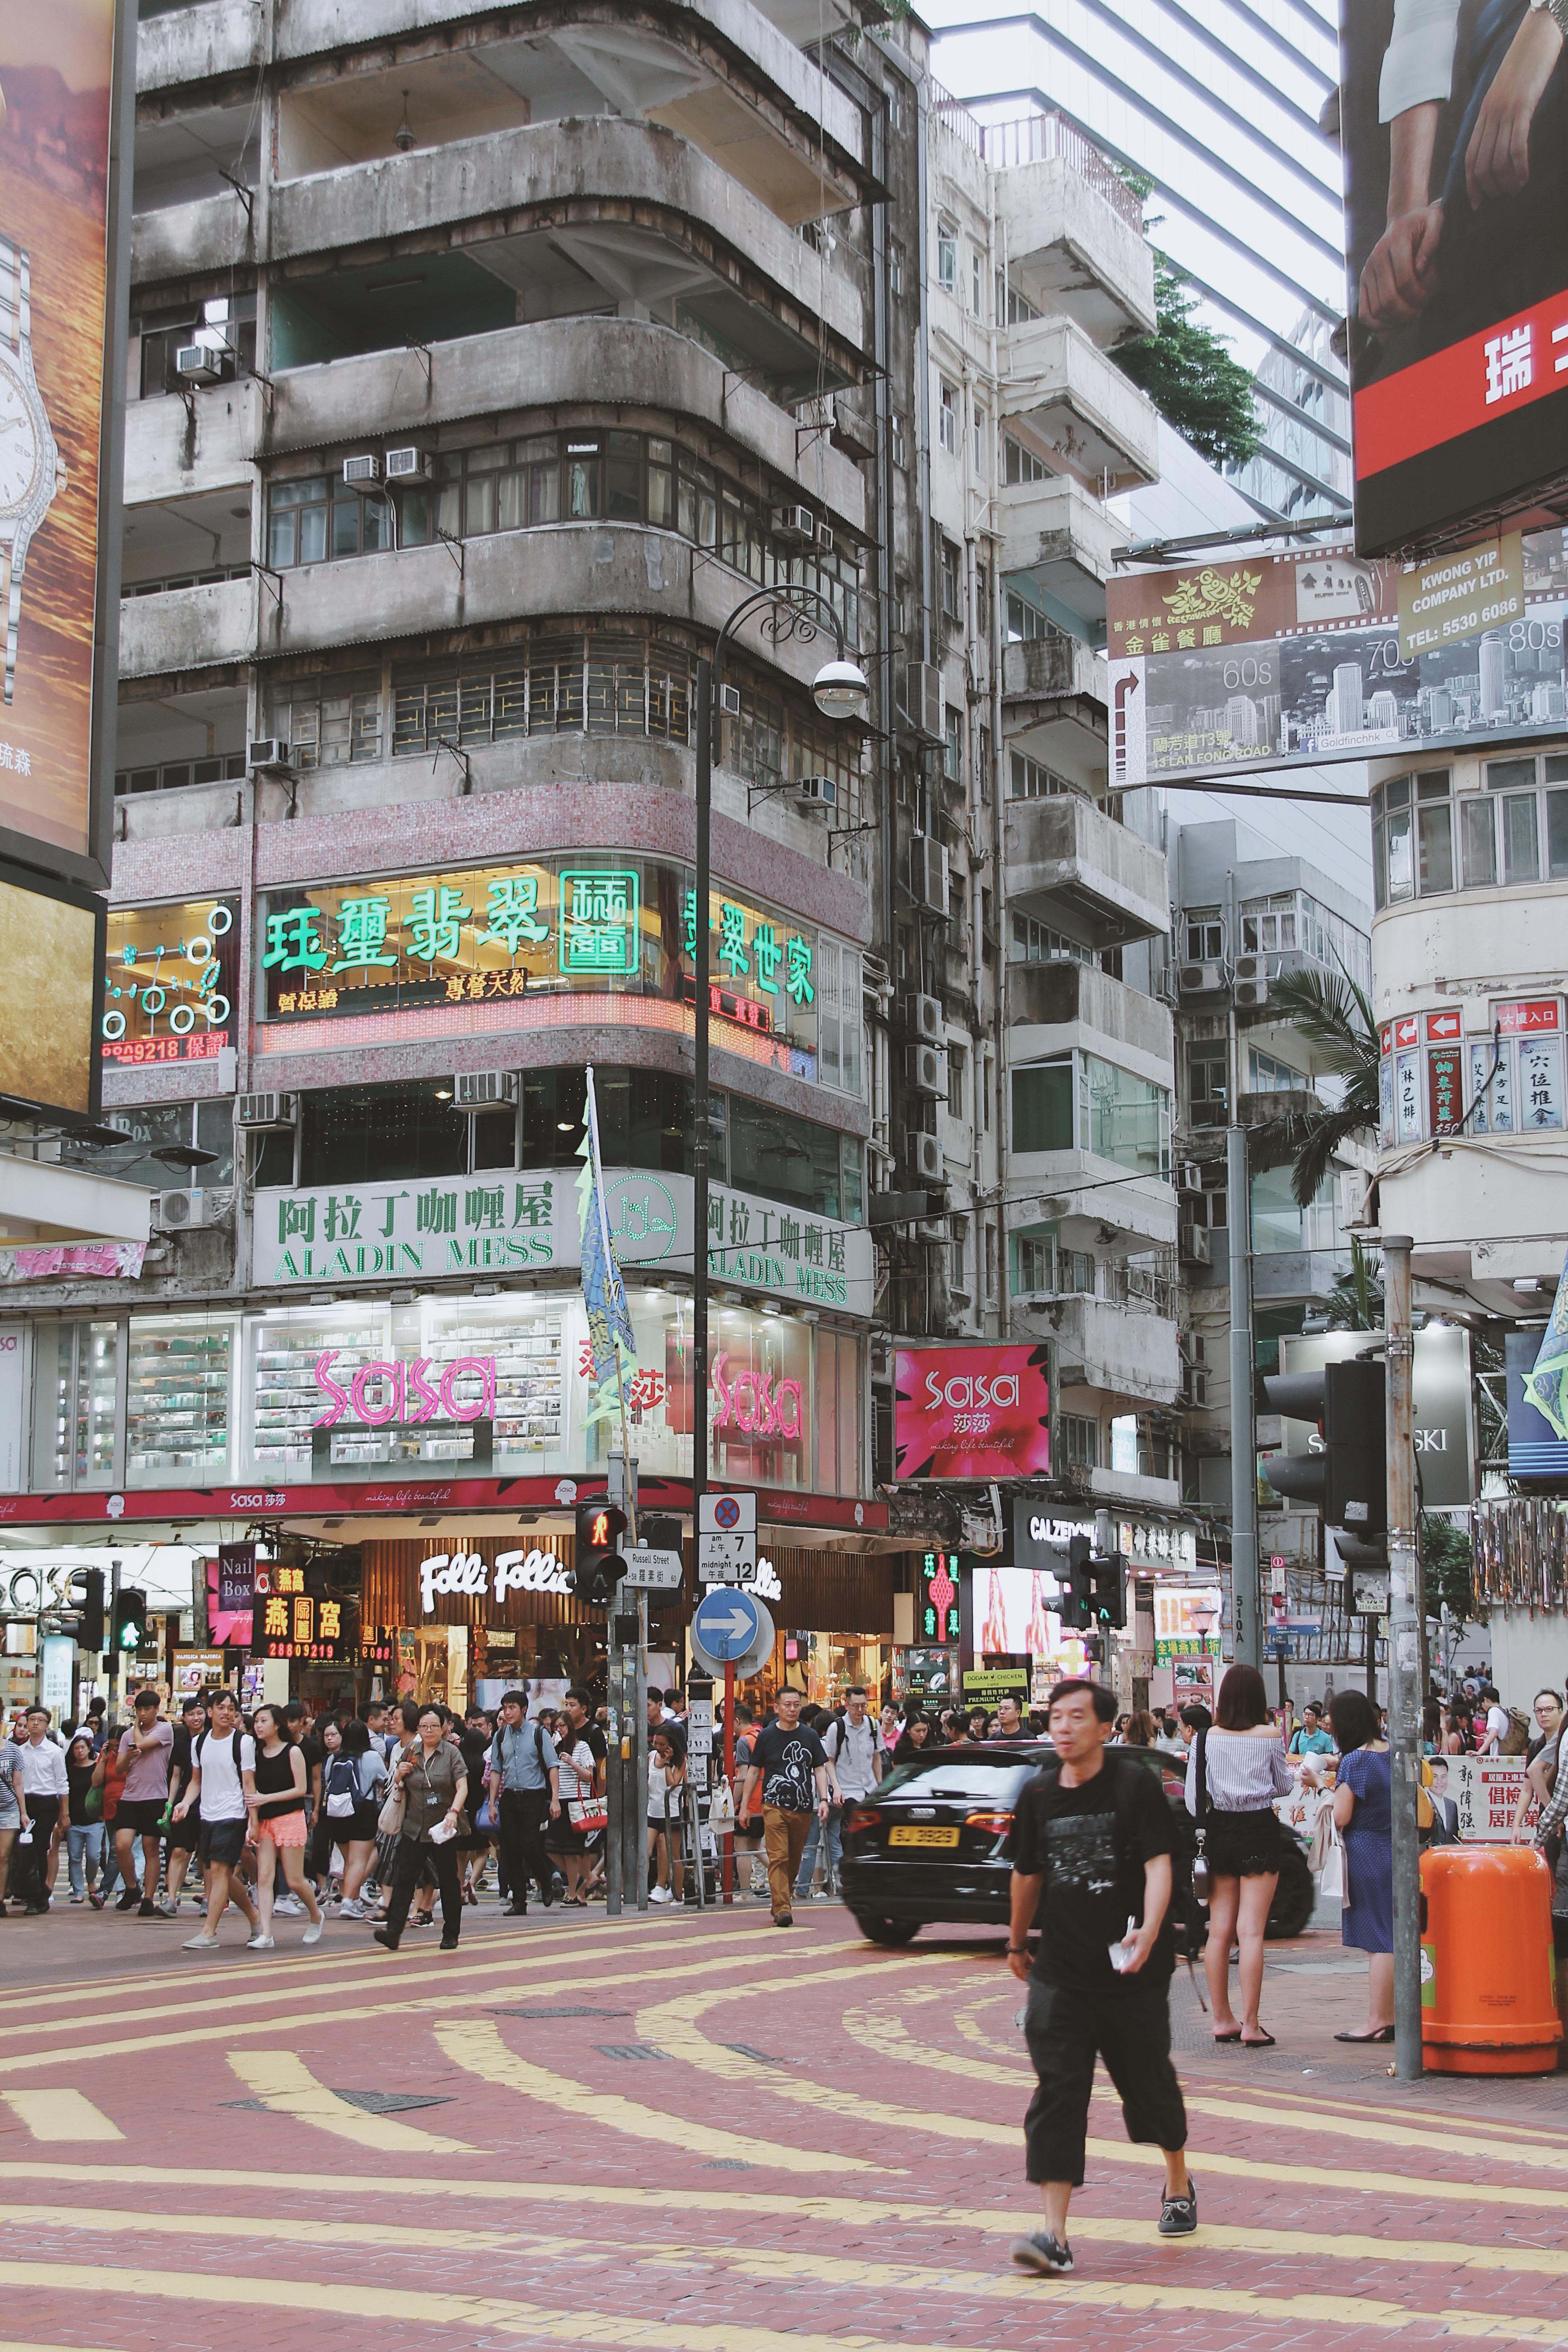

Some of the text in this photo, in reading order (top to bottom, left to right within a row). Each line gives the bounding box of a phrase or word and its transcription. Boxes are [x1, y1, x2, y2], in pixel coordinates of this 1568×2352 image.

[1421, 551, 1498, 591] KWONG YIP
[1412, 568, 1509, 614] COMPANY LTD.
[1113, 617, 1162, 633] 香港情懷
[1166, 605, 1224, 625] RESTAURANT
[1406, 597, 1517, 650] TEL: 5530 6086
[1125, 625, 1222, 656] 金雀餐廳
[1509, 621, 1561, 652] 80s
[1223, 657, 1272, 689] 60s
[1152, 730, 1231, 753] 蘭芳道13號
[1320, 732, 1380, 749] Goldfinchhk
[1152, 745, 1271, 768] 13 LAN FONG ROAD
[279, 991, 338, 1014] 質保證
[1502, 1009, 1553, 1027] 大廈入口
[1494, 1061, 1510, 1122] 古方足療
[1529, 1055, 1554, 1126] 穴位推拿
[279, 1181, 554, 1245] 阿拉丁咖喱屋
[708, 1192, 847, 1273] 阿拉丁咖喱屋
[272, 1233, 554, 1279] ALADIN MESS
[707, 1244, 848, 1305] ALADIN MESS
[925, 1371, 1019, 1410] Sasa
[953, 1412, 990, 1434] 莎莎
[930, 1438, 1014, 1454] making life beautiful
[265, 1493, 286, 1506] 莎莎
[366, 1488, 451, 1506] making life beautiful
[709, 1544, 725, 1553] 上午
[734, 1536, 744, 1552] 7
[222, 1558, 252, 1575] Nail
[632, 1553, 669, 1565] Russell Street
[701, 1560, 732, 1569] midnight
[735, 1562, 752, 1578] 12
[278, 1568, 304, 1592] 燕窩
[420, 1552, 489, 1613] Folli
[639, 1569, 663, 1583] 羅素街
[708, 1570, 725, 1579] 午夜
[223, 1580, 251, 1597] Box
[264, 1597, 289, 1637] 燕
[319, 1600, 341, 1639] 窩
[269, 1642, 334, 1659] 28809219
[891, 1647, 905, 1667] Nail
[892, 1667, 905, 1689] Box
